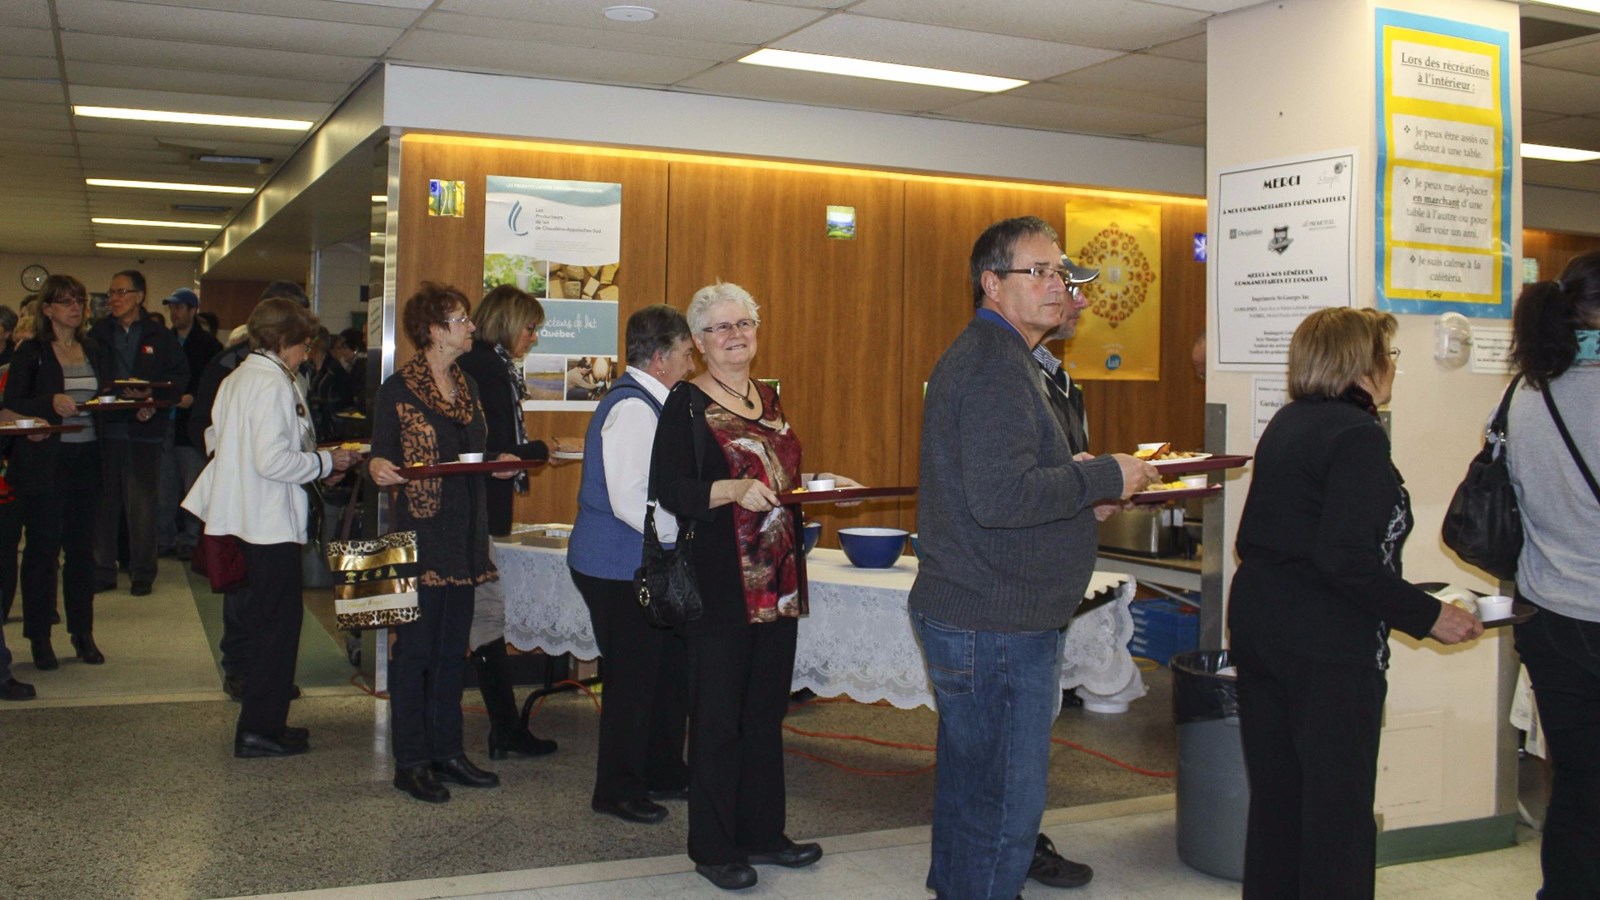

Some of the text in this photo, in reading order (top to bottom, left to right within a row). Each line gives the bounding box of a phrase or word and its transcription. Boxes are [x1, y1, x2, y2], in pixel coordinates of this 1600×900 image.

[1401, 52, 1490, 78] Lors des récréations
[1418, 72, 1422, 82] à
[1425, 73, 1470, 90] l'intérieur
[1416, 126, 1488, 146] Je peux être assis ou
[1414, 142, 1482, 159] debout à une table.
[1263, 175, 1300, 189] MERCI
[1415, 178, 1488, 196] Je peux me déplacer
[1240, 201, 1292, 214] COMMANDITAIRES
[1294, 196, 1346, 207] PRÉSENTATEURS
[1412, 194, 1482, 210] en marchant d'une
[1407, 208, 1425, 217] table
[1427, 210, 1431, 219] à
[1432, 210, 1456, 222] l'autre
[1470, 216, 1488, 226] pour
[1416, 223, 1432, 234] aller
[1434, 226, 1449, 235] voir
[1463, 229, 1478, 238] ami.
[1418, 256, 1481, 270] Je suis calme à la
[541, 329, 576, 338] Québec
